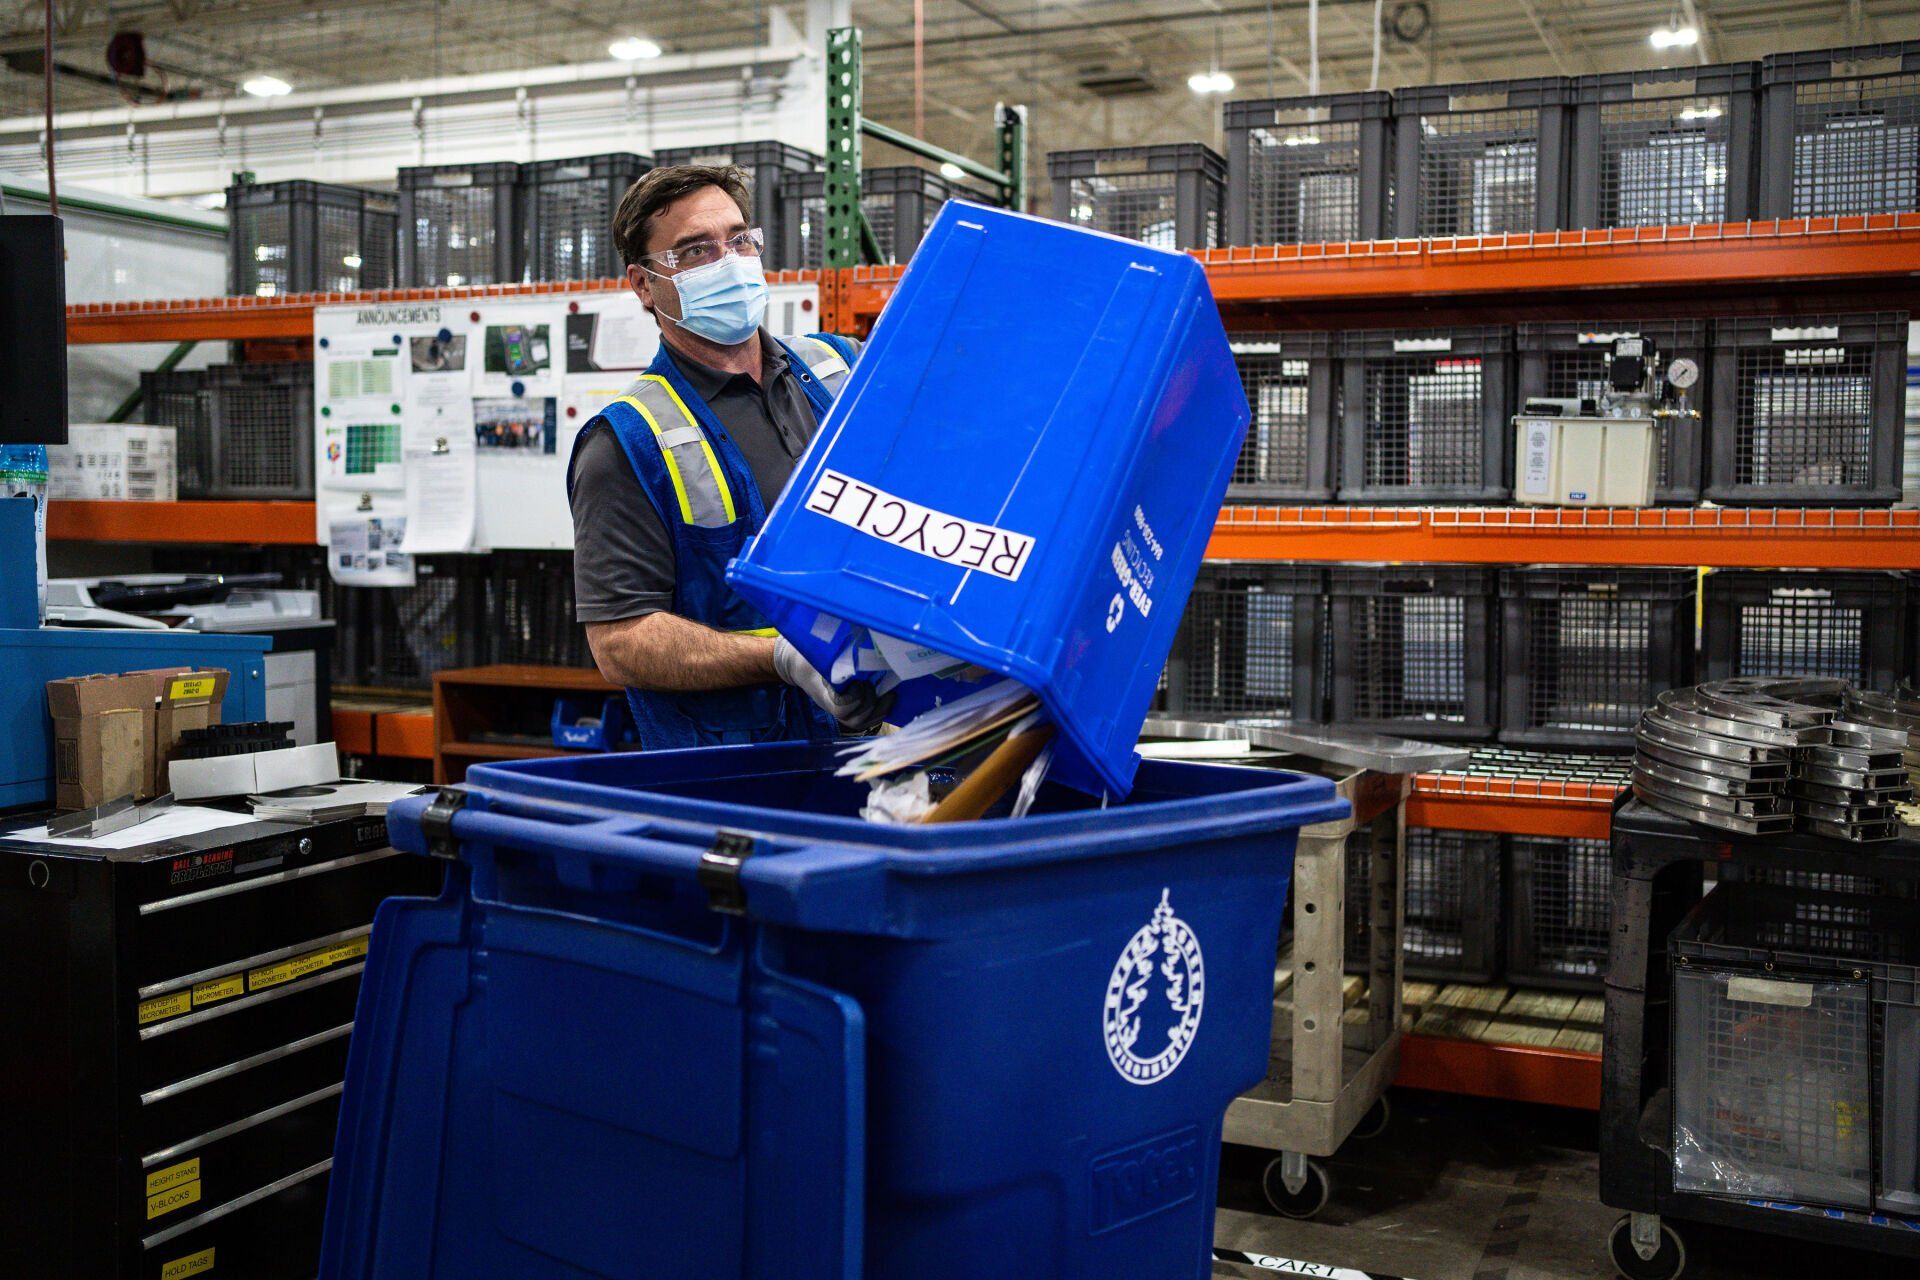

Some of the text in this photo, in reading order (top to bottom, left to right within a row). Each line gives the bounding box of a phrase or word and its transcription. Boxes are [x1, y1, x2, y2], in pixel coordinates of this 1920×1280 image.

[356, 307, 440, 324] ANNOUNCEMENTS
[811, 473, 1028, 577] RECYCLE
[203, 849, 234, 865] BEARING
[328, 947, 361, 960] MICROMETER
[261, 968, 274, 977] INCH
[290, 960, 324, 975] MICROMETER
[205, 983, 220, 992] INCH
[251, 972, 287, 987] MICROMETER
[196, 987, 234, 1002] MICROMETER
[158, 998, 178, 1008] DEPTH
[140, 1004, 181, 1020] MICROMETER
[149, 1166, 197, 1189] HEIGHT STAND
[150, 1190, 190, 1211] V-BLOCKS
[165, 1256, 209, 1278] HOLD TAGS
[1258, 1256, 1338, 1277] CART
